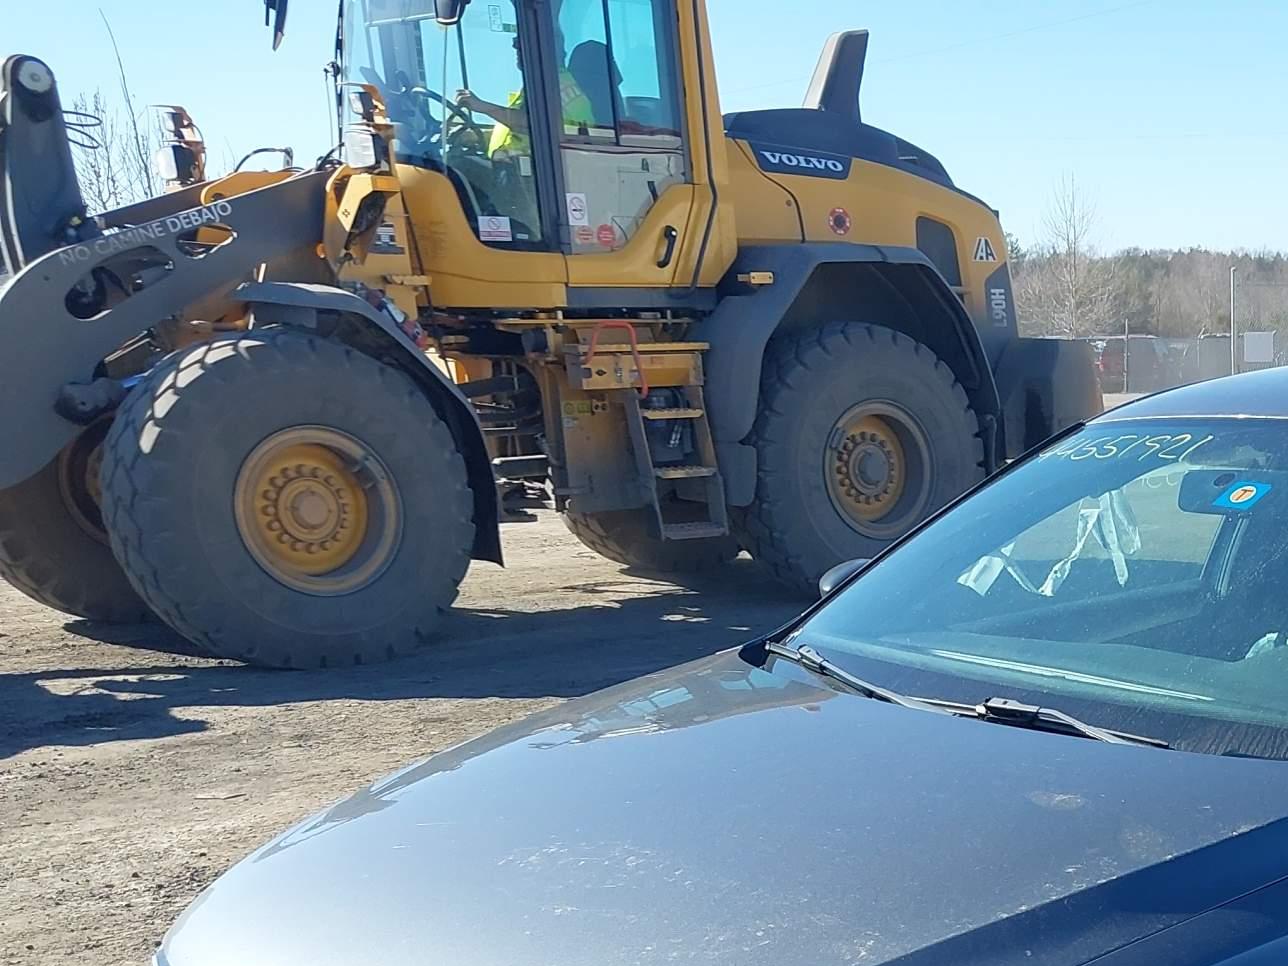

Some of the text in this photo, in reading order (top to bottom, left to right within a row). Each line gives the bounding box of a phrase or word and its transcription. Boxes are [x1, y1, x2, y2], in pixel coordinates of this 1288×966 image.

[759, 150, 844, 172] VOLVO
[58, 202, 233, 265] NO CAMINE DEBAJO
[990, 288, 1008, 328] L90H
[1038, 433, 1214, 463] 44551921
